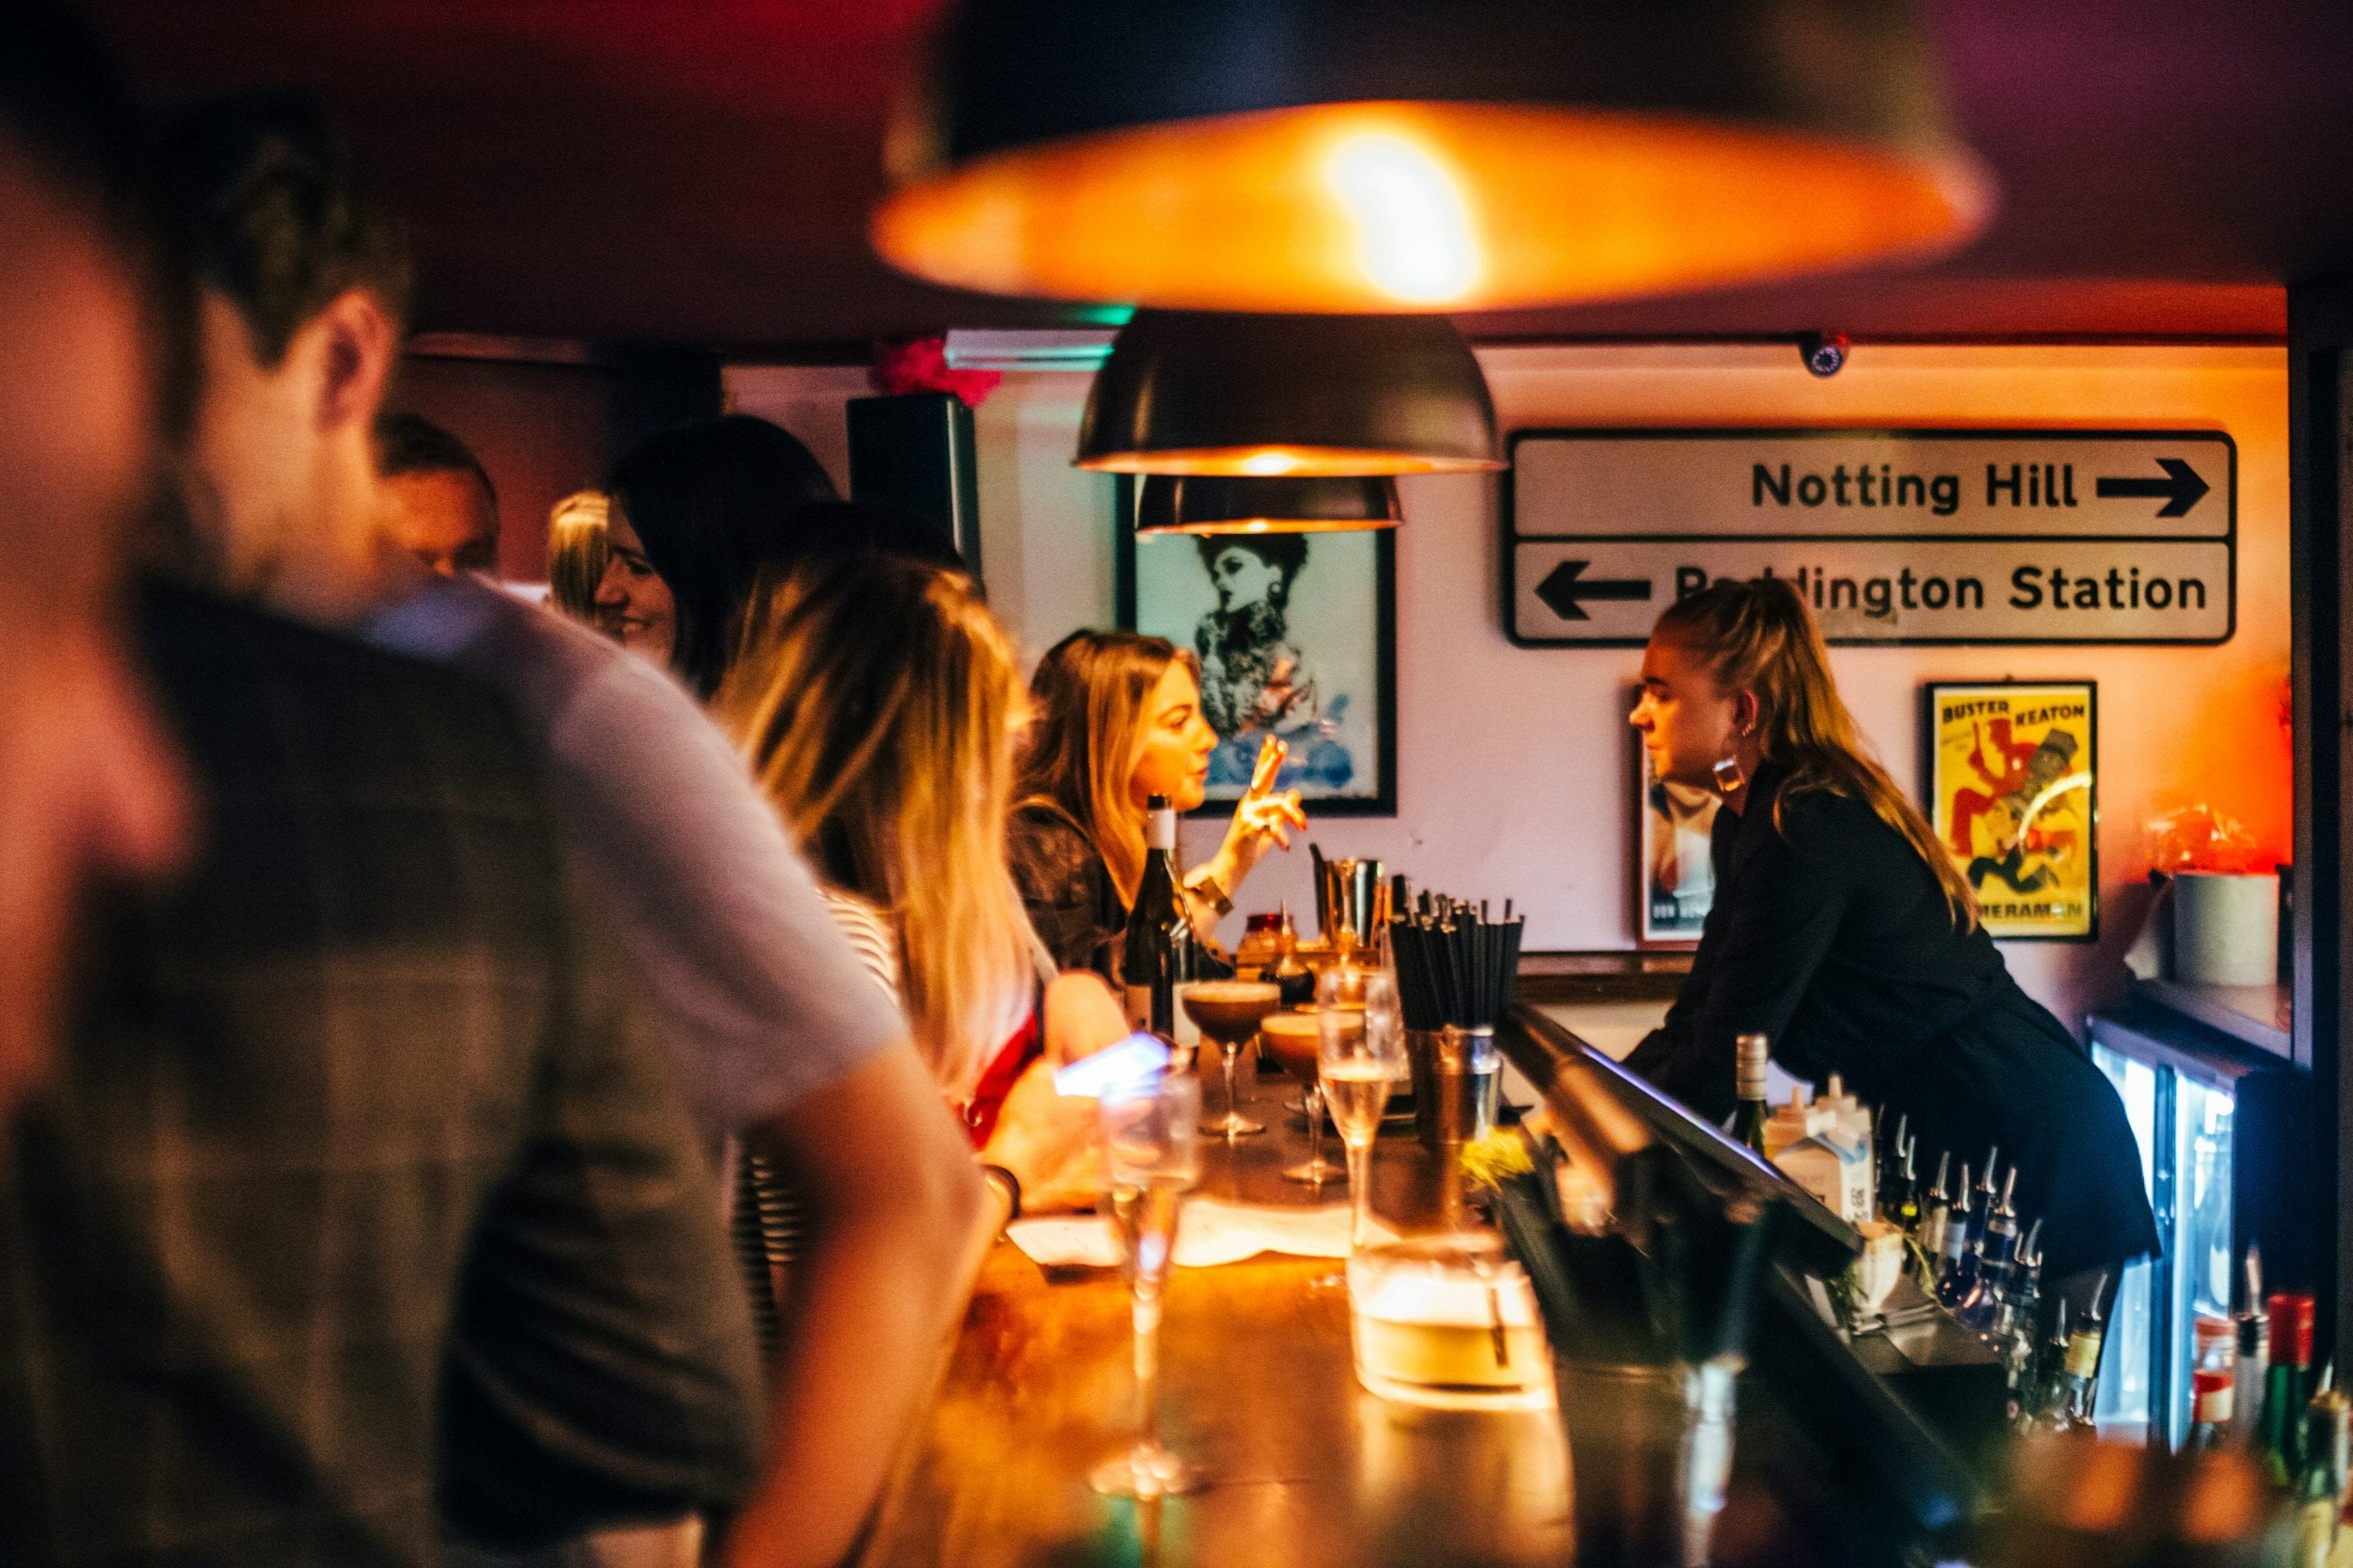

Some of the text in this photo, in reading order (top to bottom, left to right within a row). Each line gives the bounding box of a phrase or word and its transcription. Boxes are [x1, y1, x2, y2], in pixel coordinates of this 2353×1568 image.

[1751, 463, 2077, 516] Notting Hill
[1675, 566, 2207, 618] Pington Station
[1943, 700, 2085, 726] BUSTER KEATON
